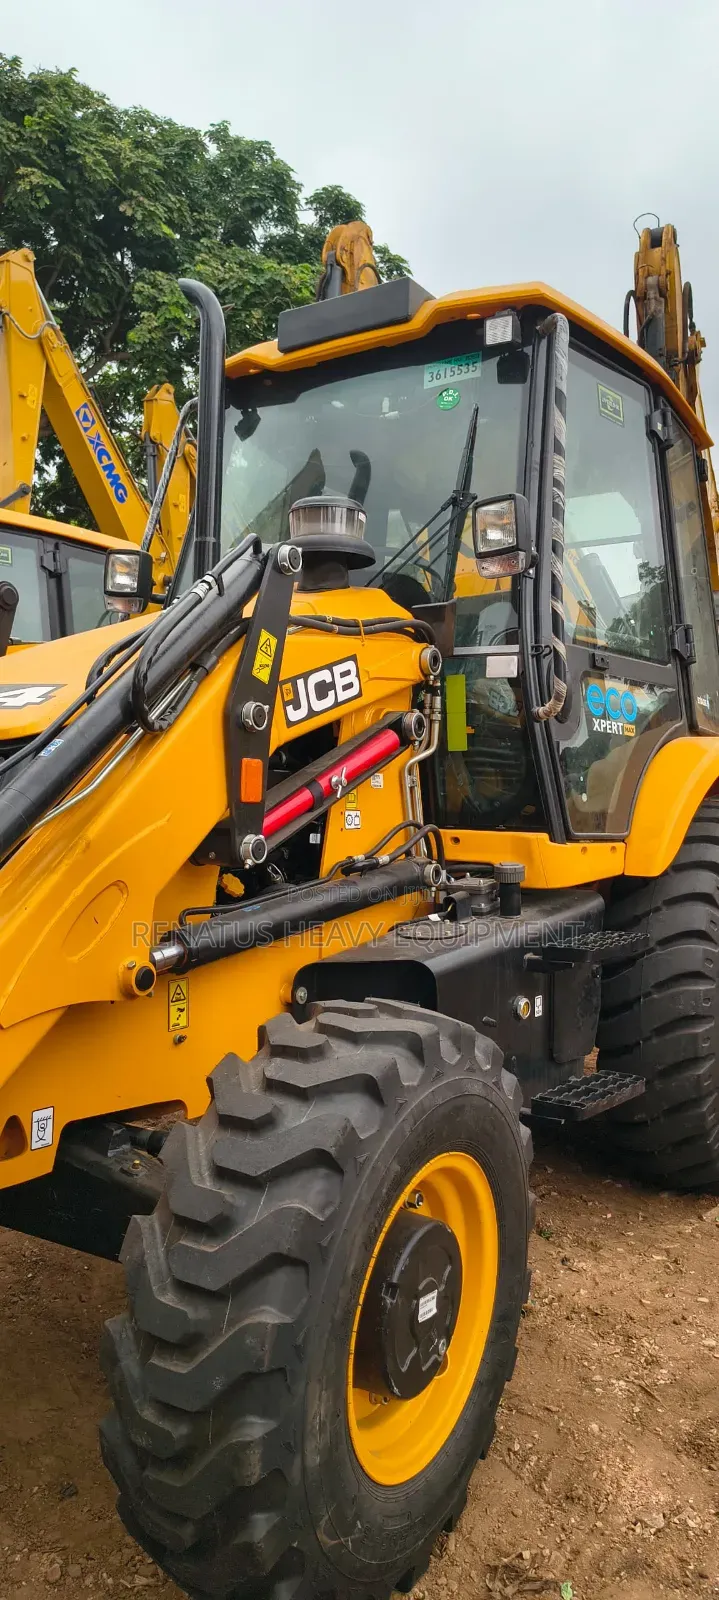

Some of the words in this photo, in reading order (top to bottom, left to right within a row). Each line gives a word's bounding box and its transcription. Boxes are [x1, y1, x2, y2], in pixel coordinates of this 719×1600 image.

[427, 361, 478, 383] 3615535
[86, 430, 128, 504] XCMG
[0, 686, 57, 707] 4
[285, 660, 360, 722] JCB
[586, 683, 638, 722] eco
[592, 717, 624, 735] XPERT
[624, 725, 635, 734] MAX
